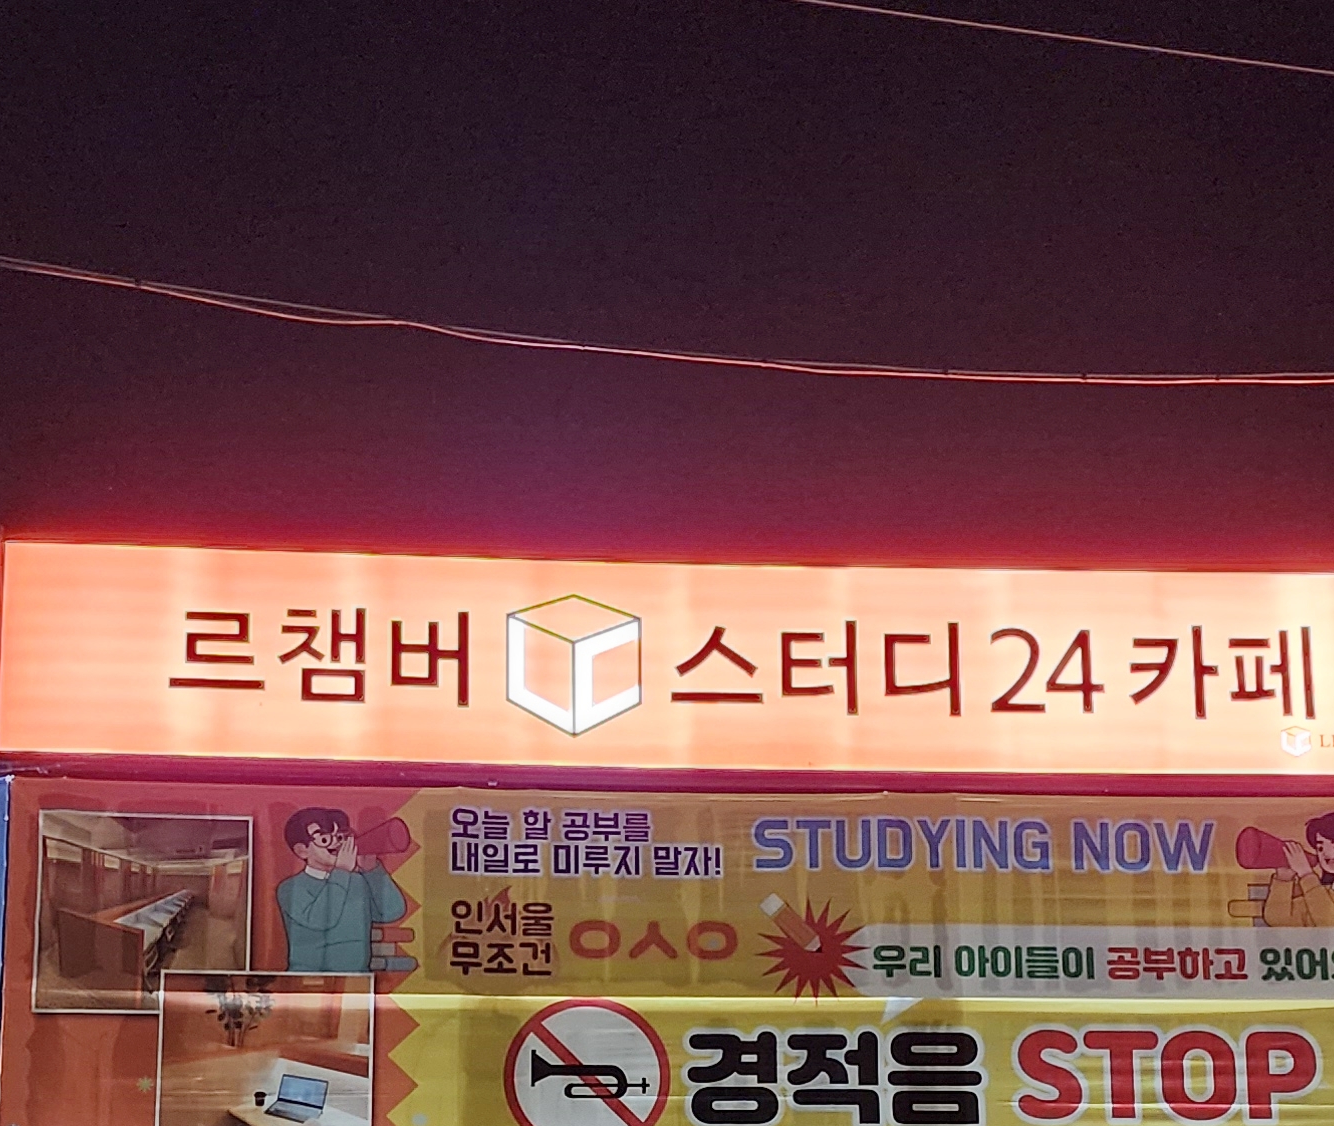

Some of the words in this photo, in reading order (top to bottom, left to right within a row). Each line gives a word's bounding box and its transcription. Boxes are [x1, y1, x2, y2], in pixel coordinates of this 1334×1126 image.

[168, 607, 469, 707] 르챔버
[450, 808, 510, 840] 오늘
[523, 809, 552, 841] 할
[561, 811, 652, 842] 공부를
[451, 843, 541, 875] 내일로
[553, 843, 641, 876] 미루지
[653, 845, 722, 877] 말자!
[753, 818, 1051, 871] STUDYING
[1074, 820, 1214, 872] NOW
[450, 900, 555, 936] 인서울
[450, 942, 553, 976] 무조건
[872, 944, 942, 979] 우리
[954, 945, 1095, 980] 아이들이
[1106, 946, 1248, 981] 공부하고
[685, 1029, 981, 1125] 경적음
[1016, 1028, 1319, 1120] STOP
